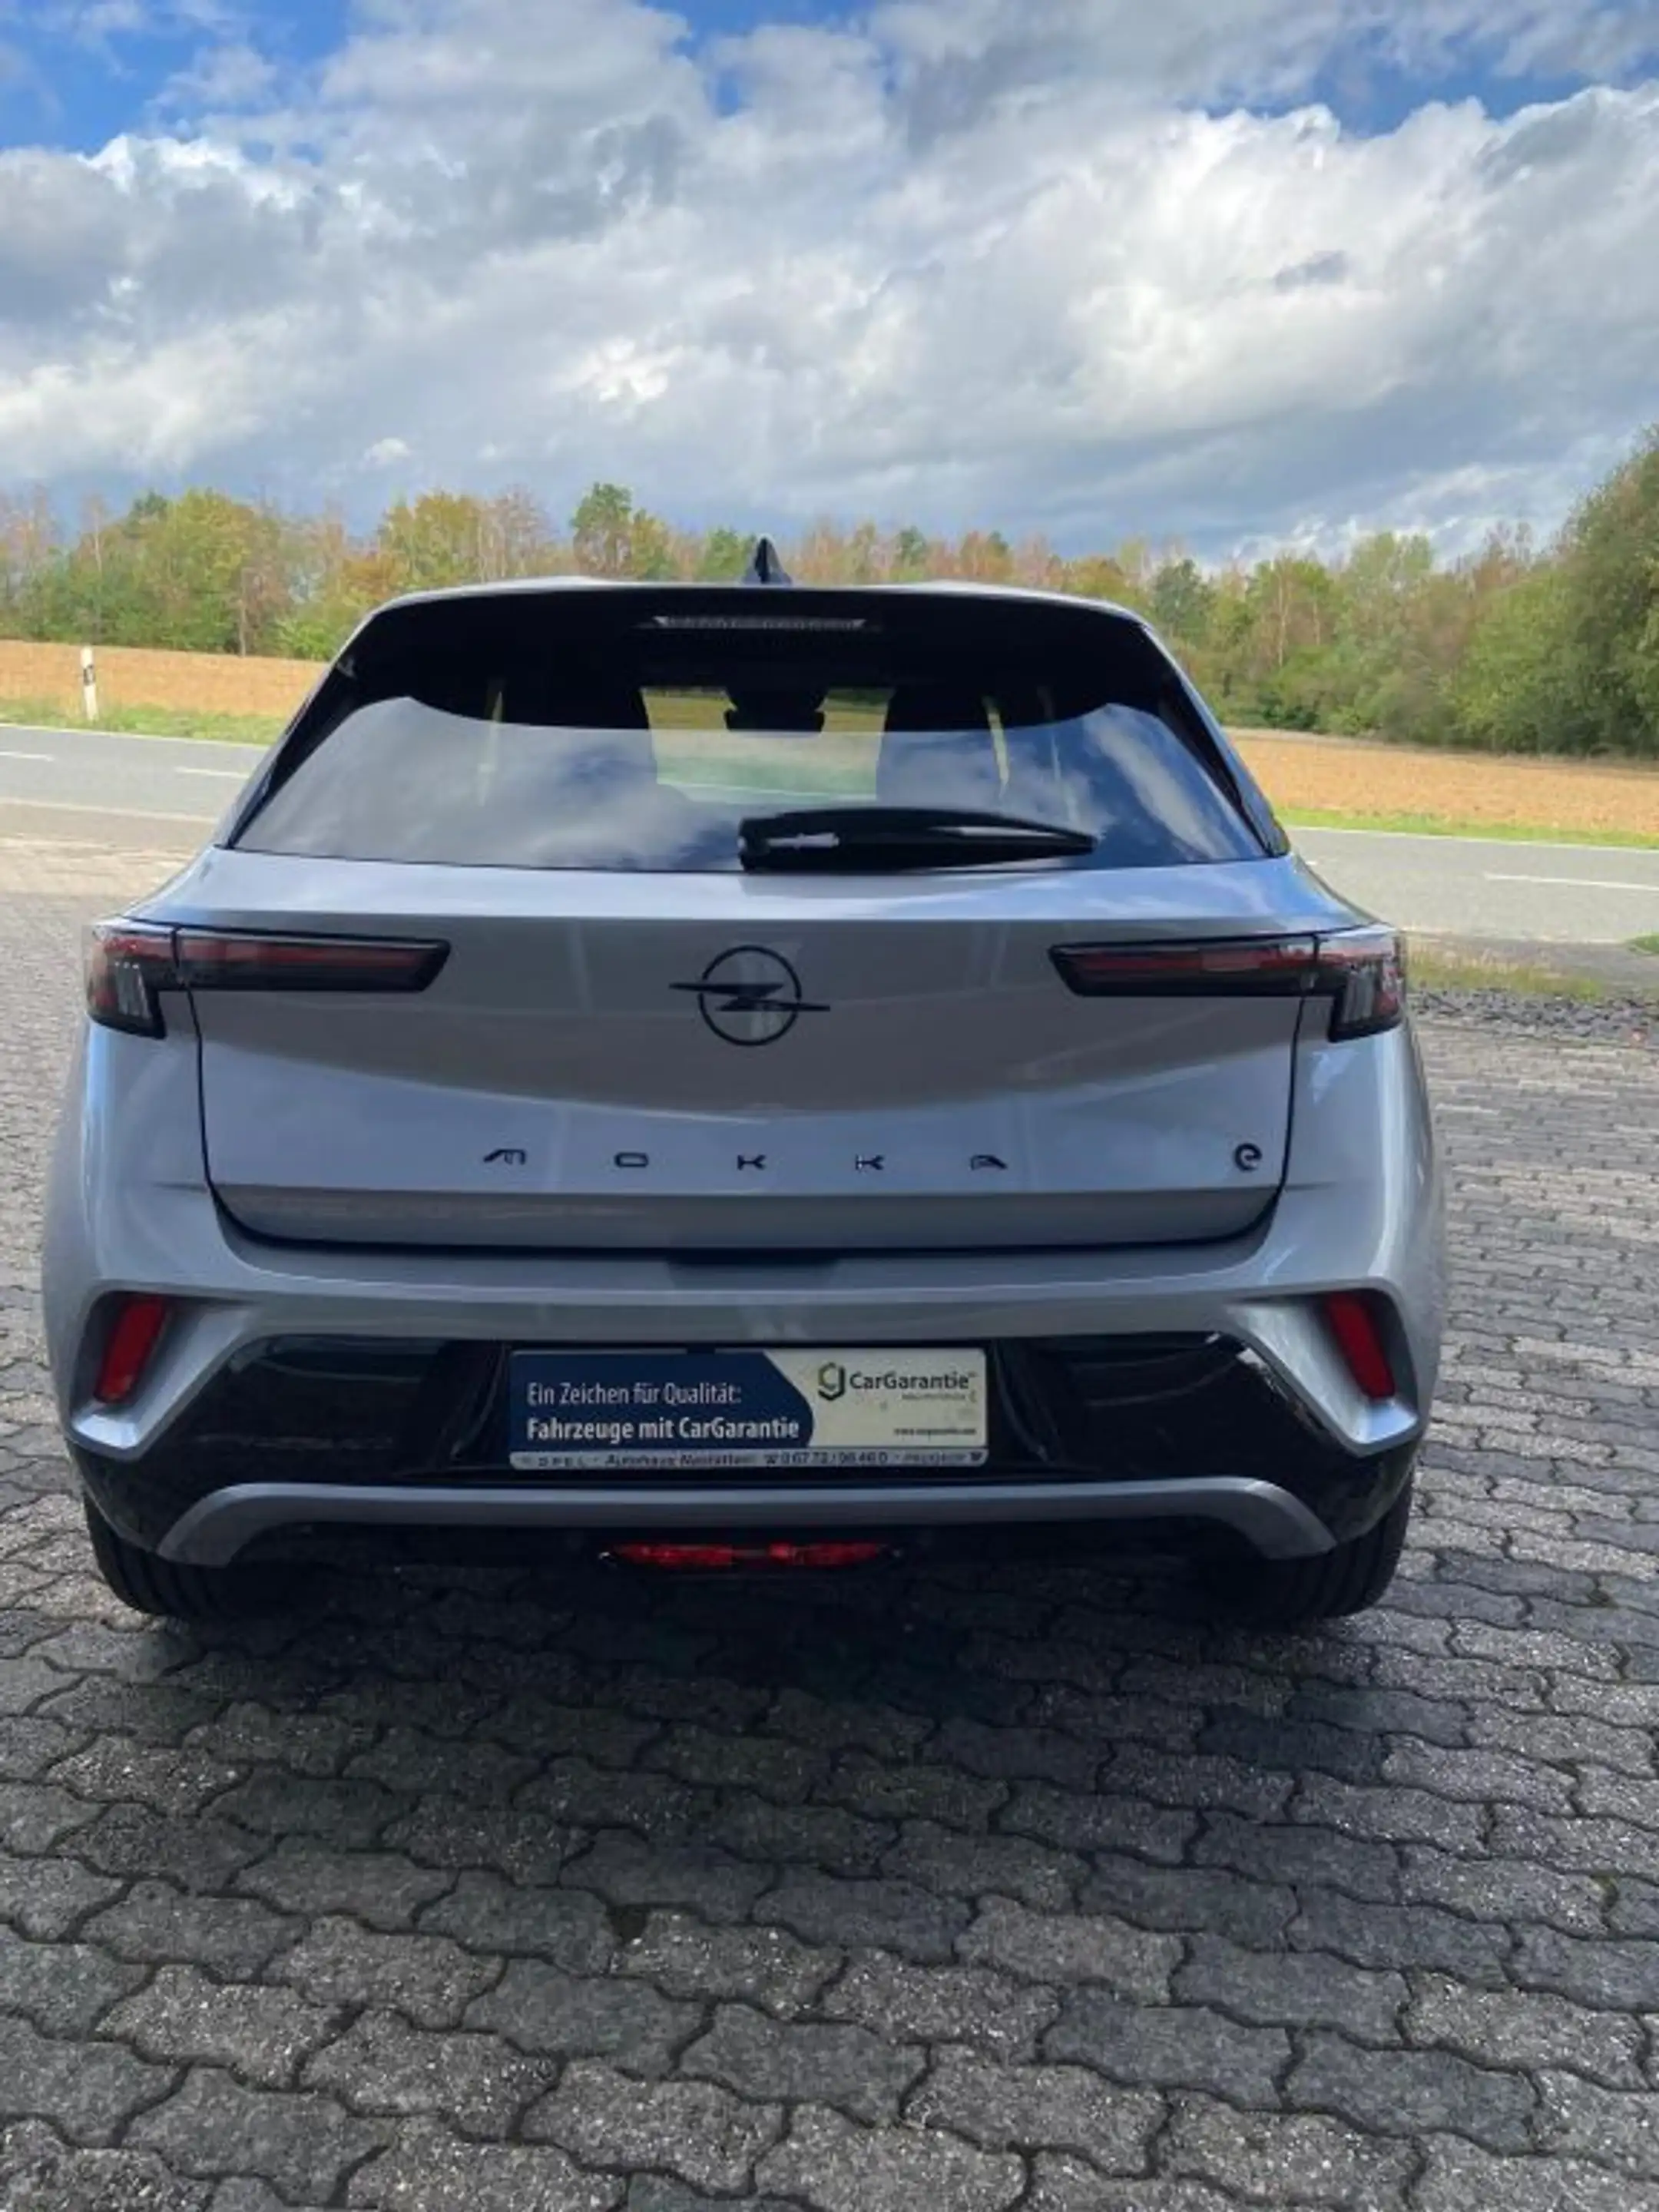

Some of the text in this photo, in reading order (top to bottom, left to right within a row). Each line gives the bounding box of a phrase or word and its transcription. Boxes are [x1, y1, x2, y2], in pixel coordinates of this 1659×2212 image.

[849, 1370, 969, 1389] CarGarantie
[527, 1382, 742, 1406] Ein Zeichen für Qualität:
[527, 1416, 800, 1445] Fahrzeuge mit CarGarantie
